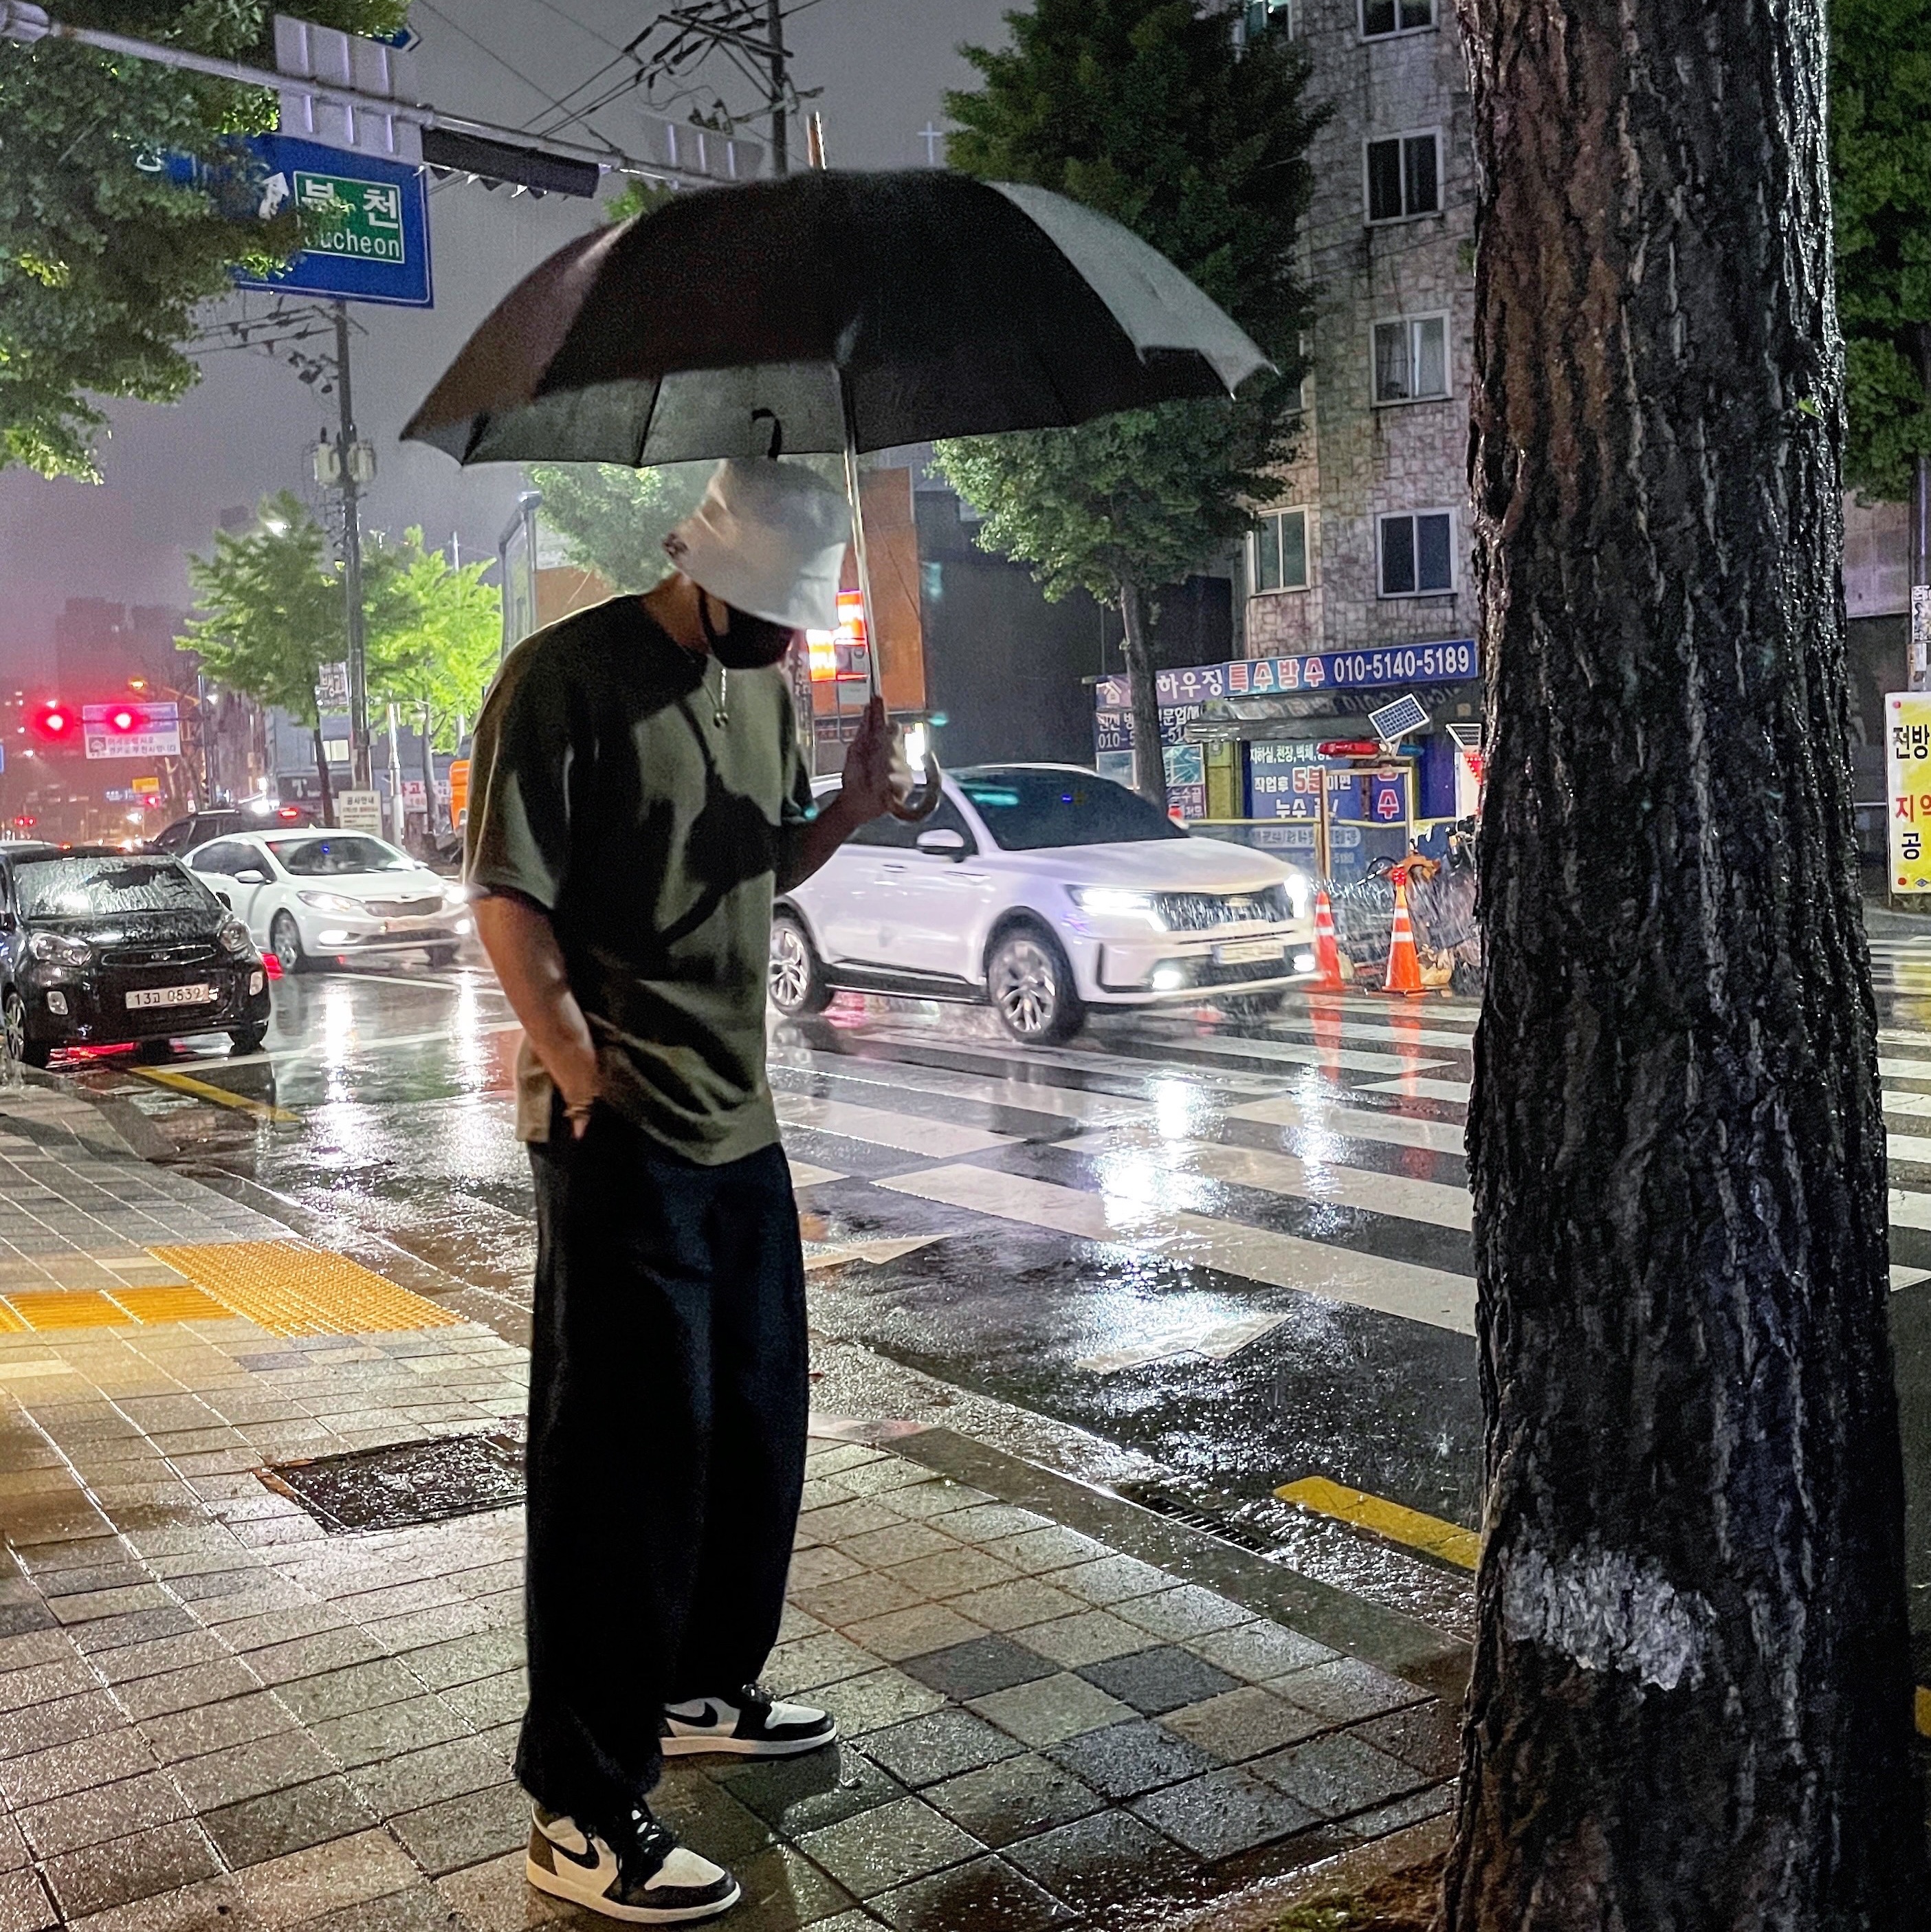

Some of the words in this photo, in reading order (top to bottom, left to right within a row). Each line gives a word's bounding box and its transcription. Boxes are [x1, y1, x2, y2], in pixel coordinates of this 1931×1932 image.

[1228, 657, 1325, 692] 특수방수
[1334, 645, 1469, 682] 010-5140-5189
[1893, 724, 1930, 759] 전방
